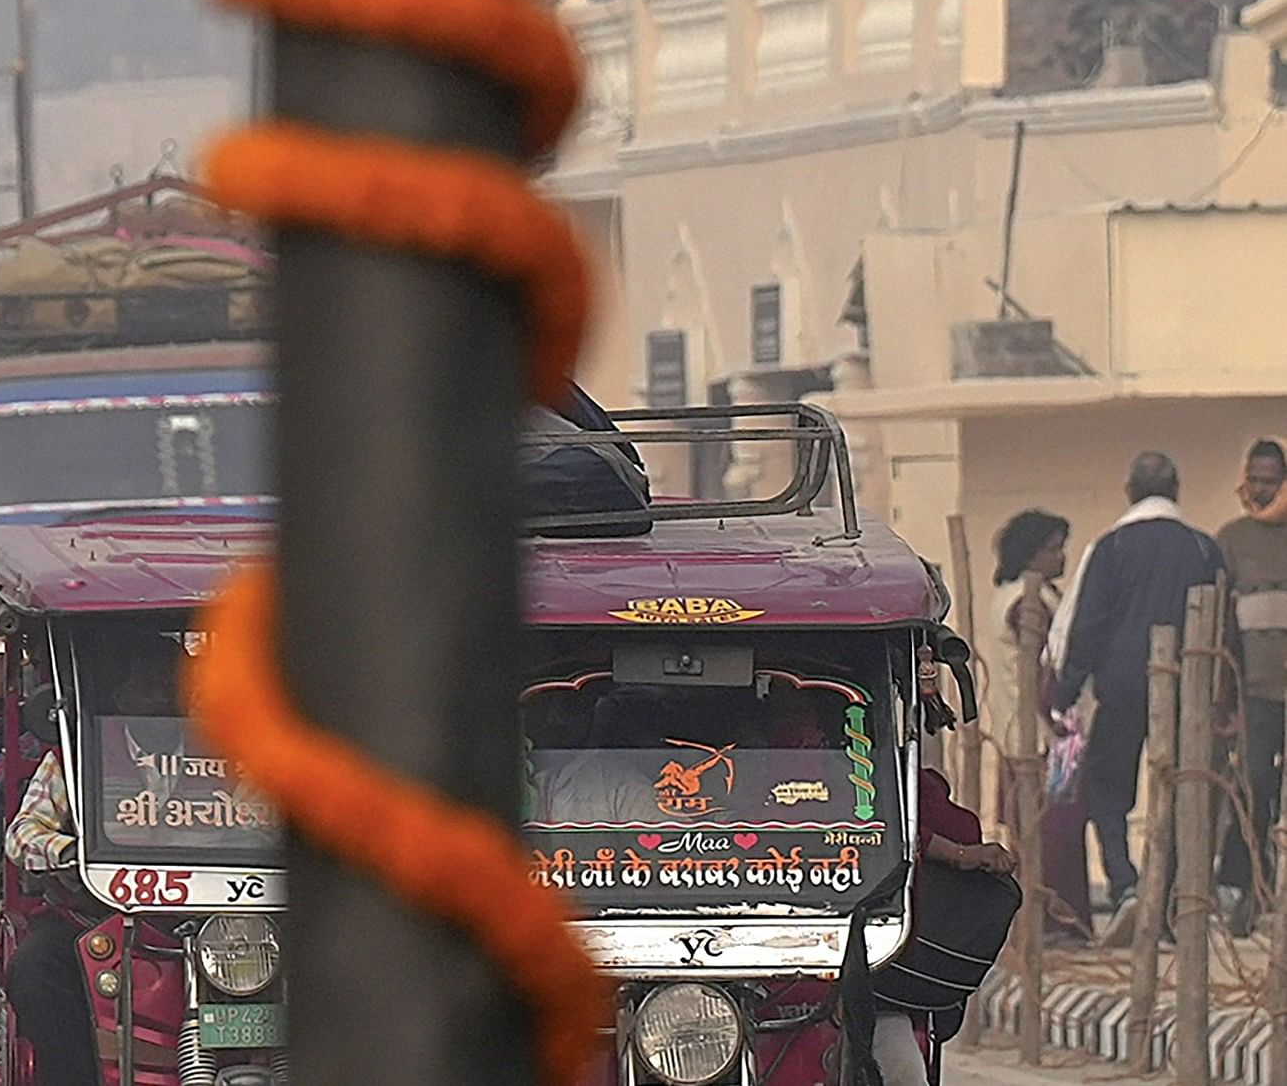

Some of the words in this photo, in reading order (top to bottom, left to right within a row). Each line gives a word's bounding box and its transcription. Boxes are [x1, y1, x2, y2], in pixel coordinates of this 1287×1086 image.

[633, 597, 731, 615] BABA
[183, 756, 228, 778] जय
[116, 790, 159, 828] श्री
[654, 796, 726, 818] राम
[657, 832, 731, 853] Maa
[527, 848, 576, 889] मेरी
[580, 847, 617, 888] माँ
[620, 849, 653, 888] के
[657, 857, 741, 889] बराबर
[746, 845, 804, 894] कोई
[109, 867, 193, 906] 685
